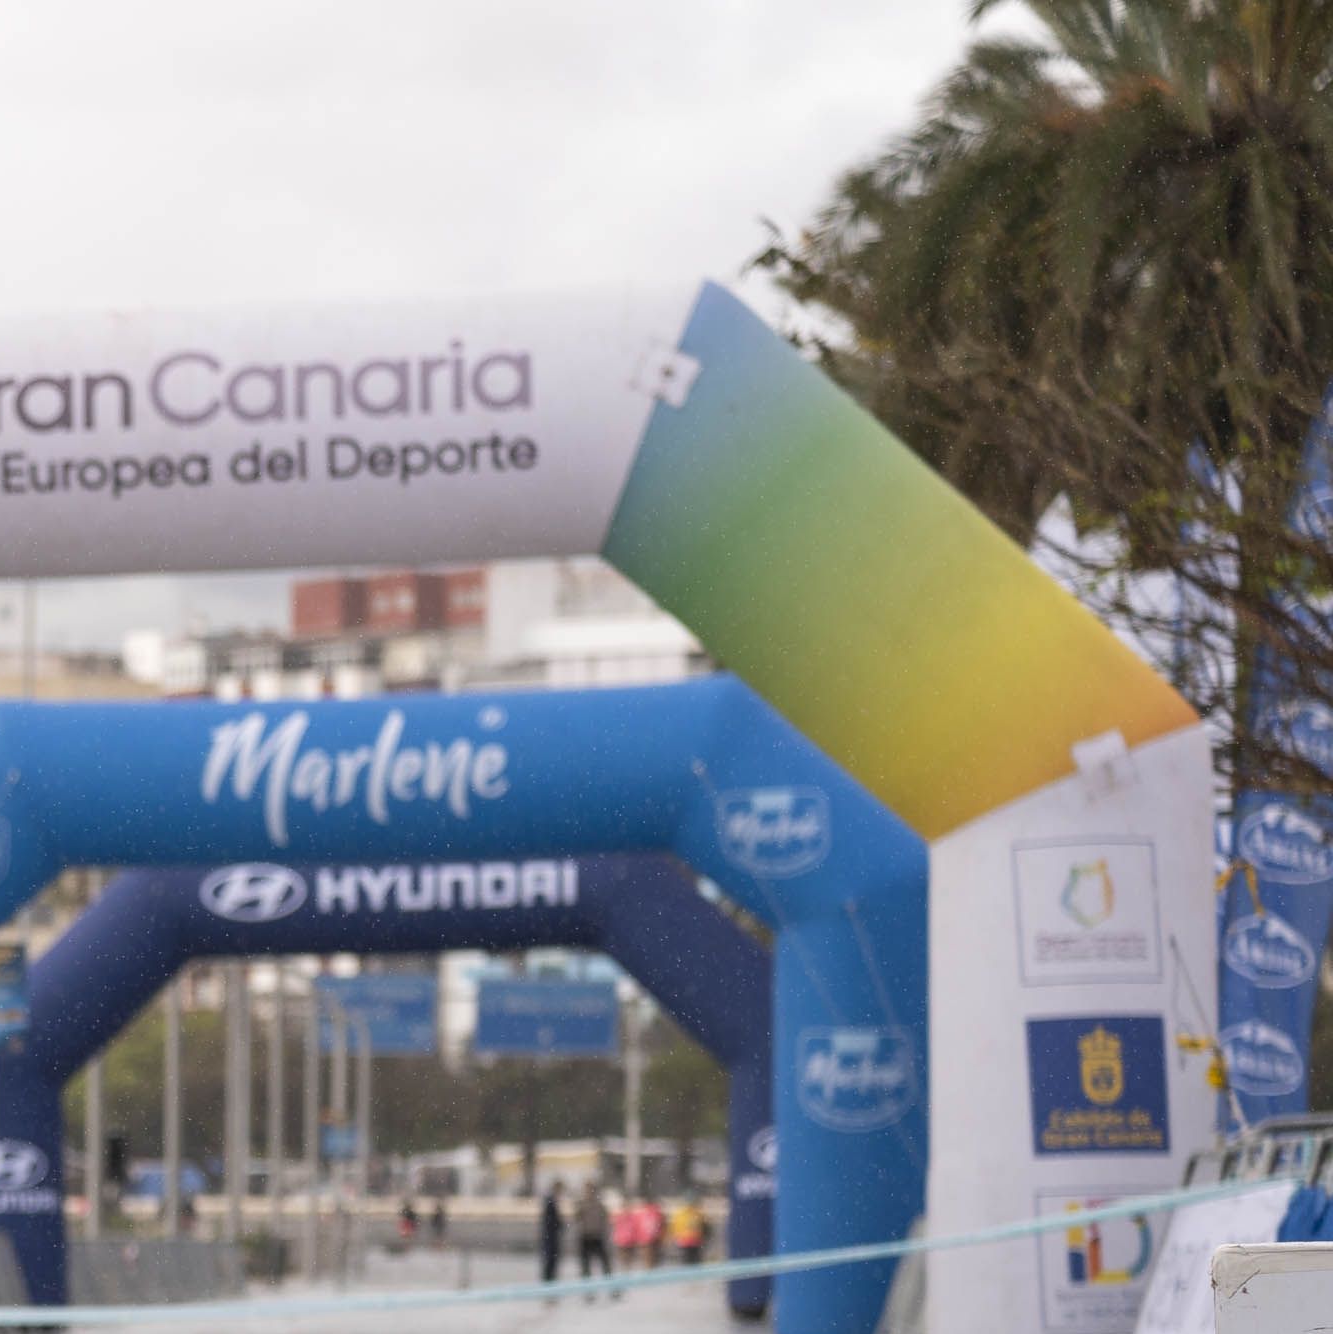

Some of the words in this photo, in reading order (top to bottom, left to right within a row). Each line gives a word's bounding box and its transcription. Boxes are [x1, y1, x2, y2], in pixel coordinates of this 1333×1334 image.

[2, 448, 211, 499] Europea
[230, 439, 308, 486] del
[328, 434, 538, 487] Deporte
[199, 707, 511, 848] Marlene
[316, 859, 578, 914] HYUNDAI
